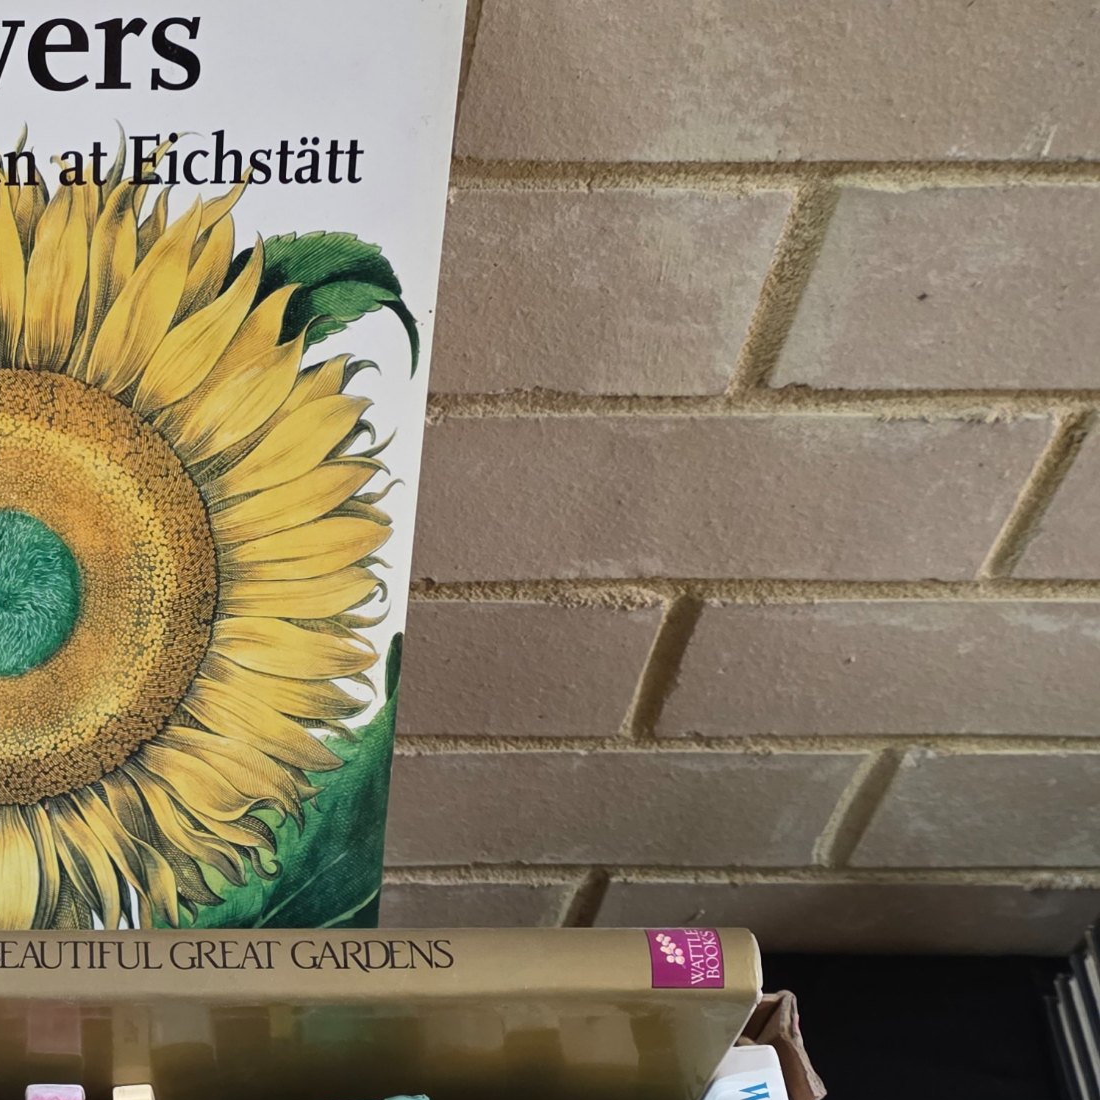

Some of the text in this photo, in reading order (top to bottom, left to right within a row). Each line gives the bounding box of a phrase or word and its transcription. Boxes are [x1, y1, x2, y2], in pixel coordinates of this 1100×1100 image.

[57, 144, 110, 188] at
[133, 133, 364, 188] Eichstätt
[169, 940, 281, 971] GREAT
[290, 939, 455, 973] GARDENS
[701, 930, 720, 979] BOOKS
